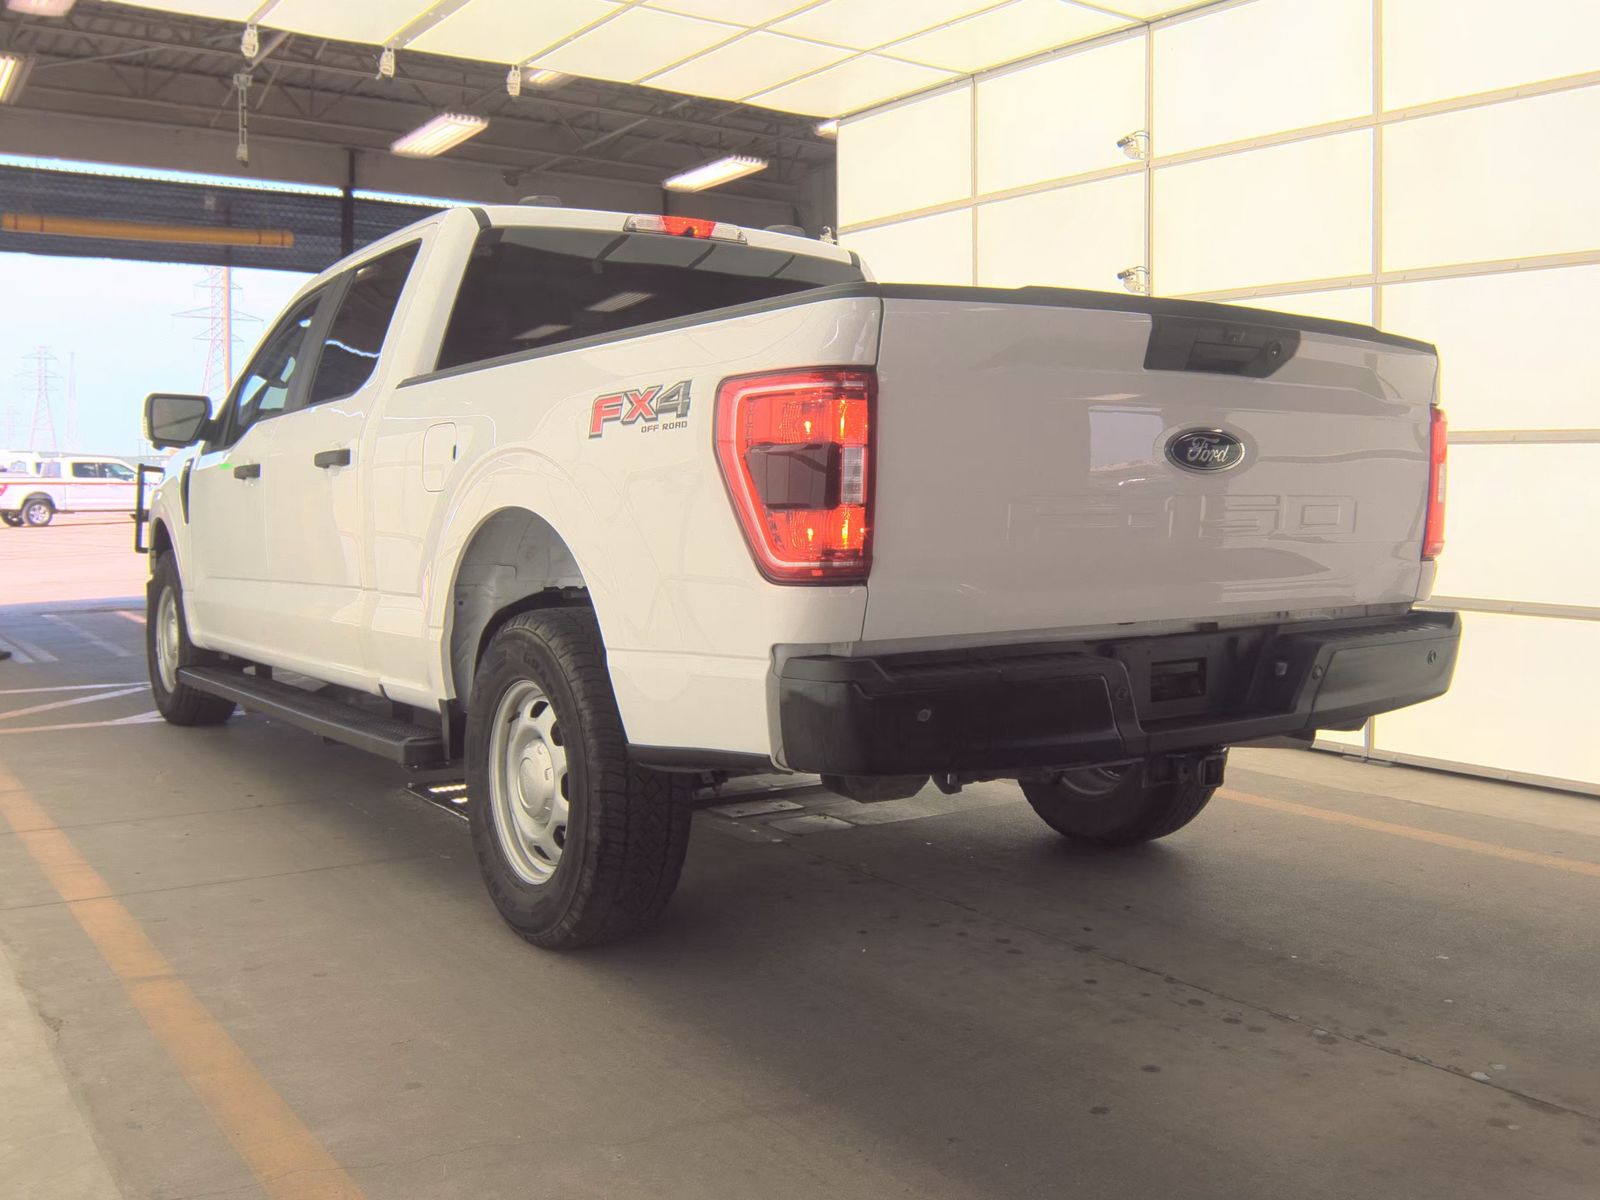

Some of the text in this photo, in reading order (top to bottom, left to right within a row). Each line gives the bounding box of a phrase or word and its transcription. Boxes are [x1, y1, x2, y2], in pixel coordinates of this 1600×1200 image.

[588, 379, 692, 439] FX4
[641, 421, 688, 433] OFF ROAD
[1184, 437, 1230, 463] Ford
